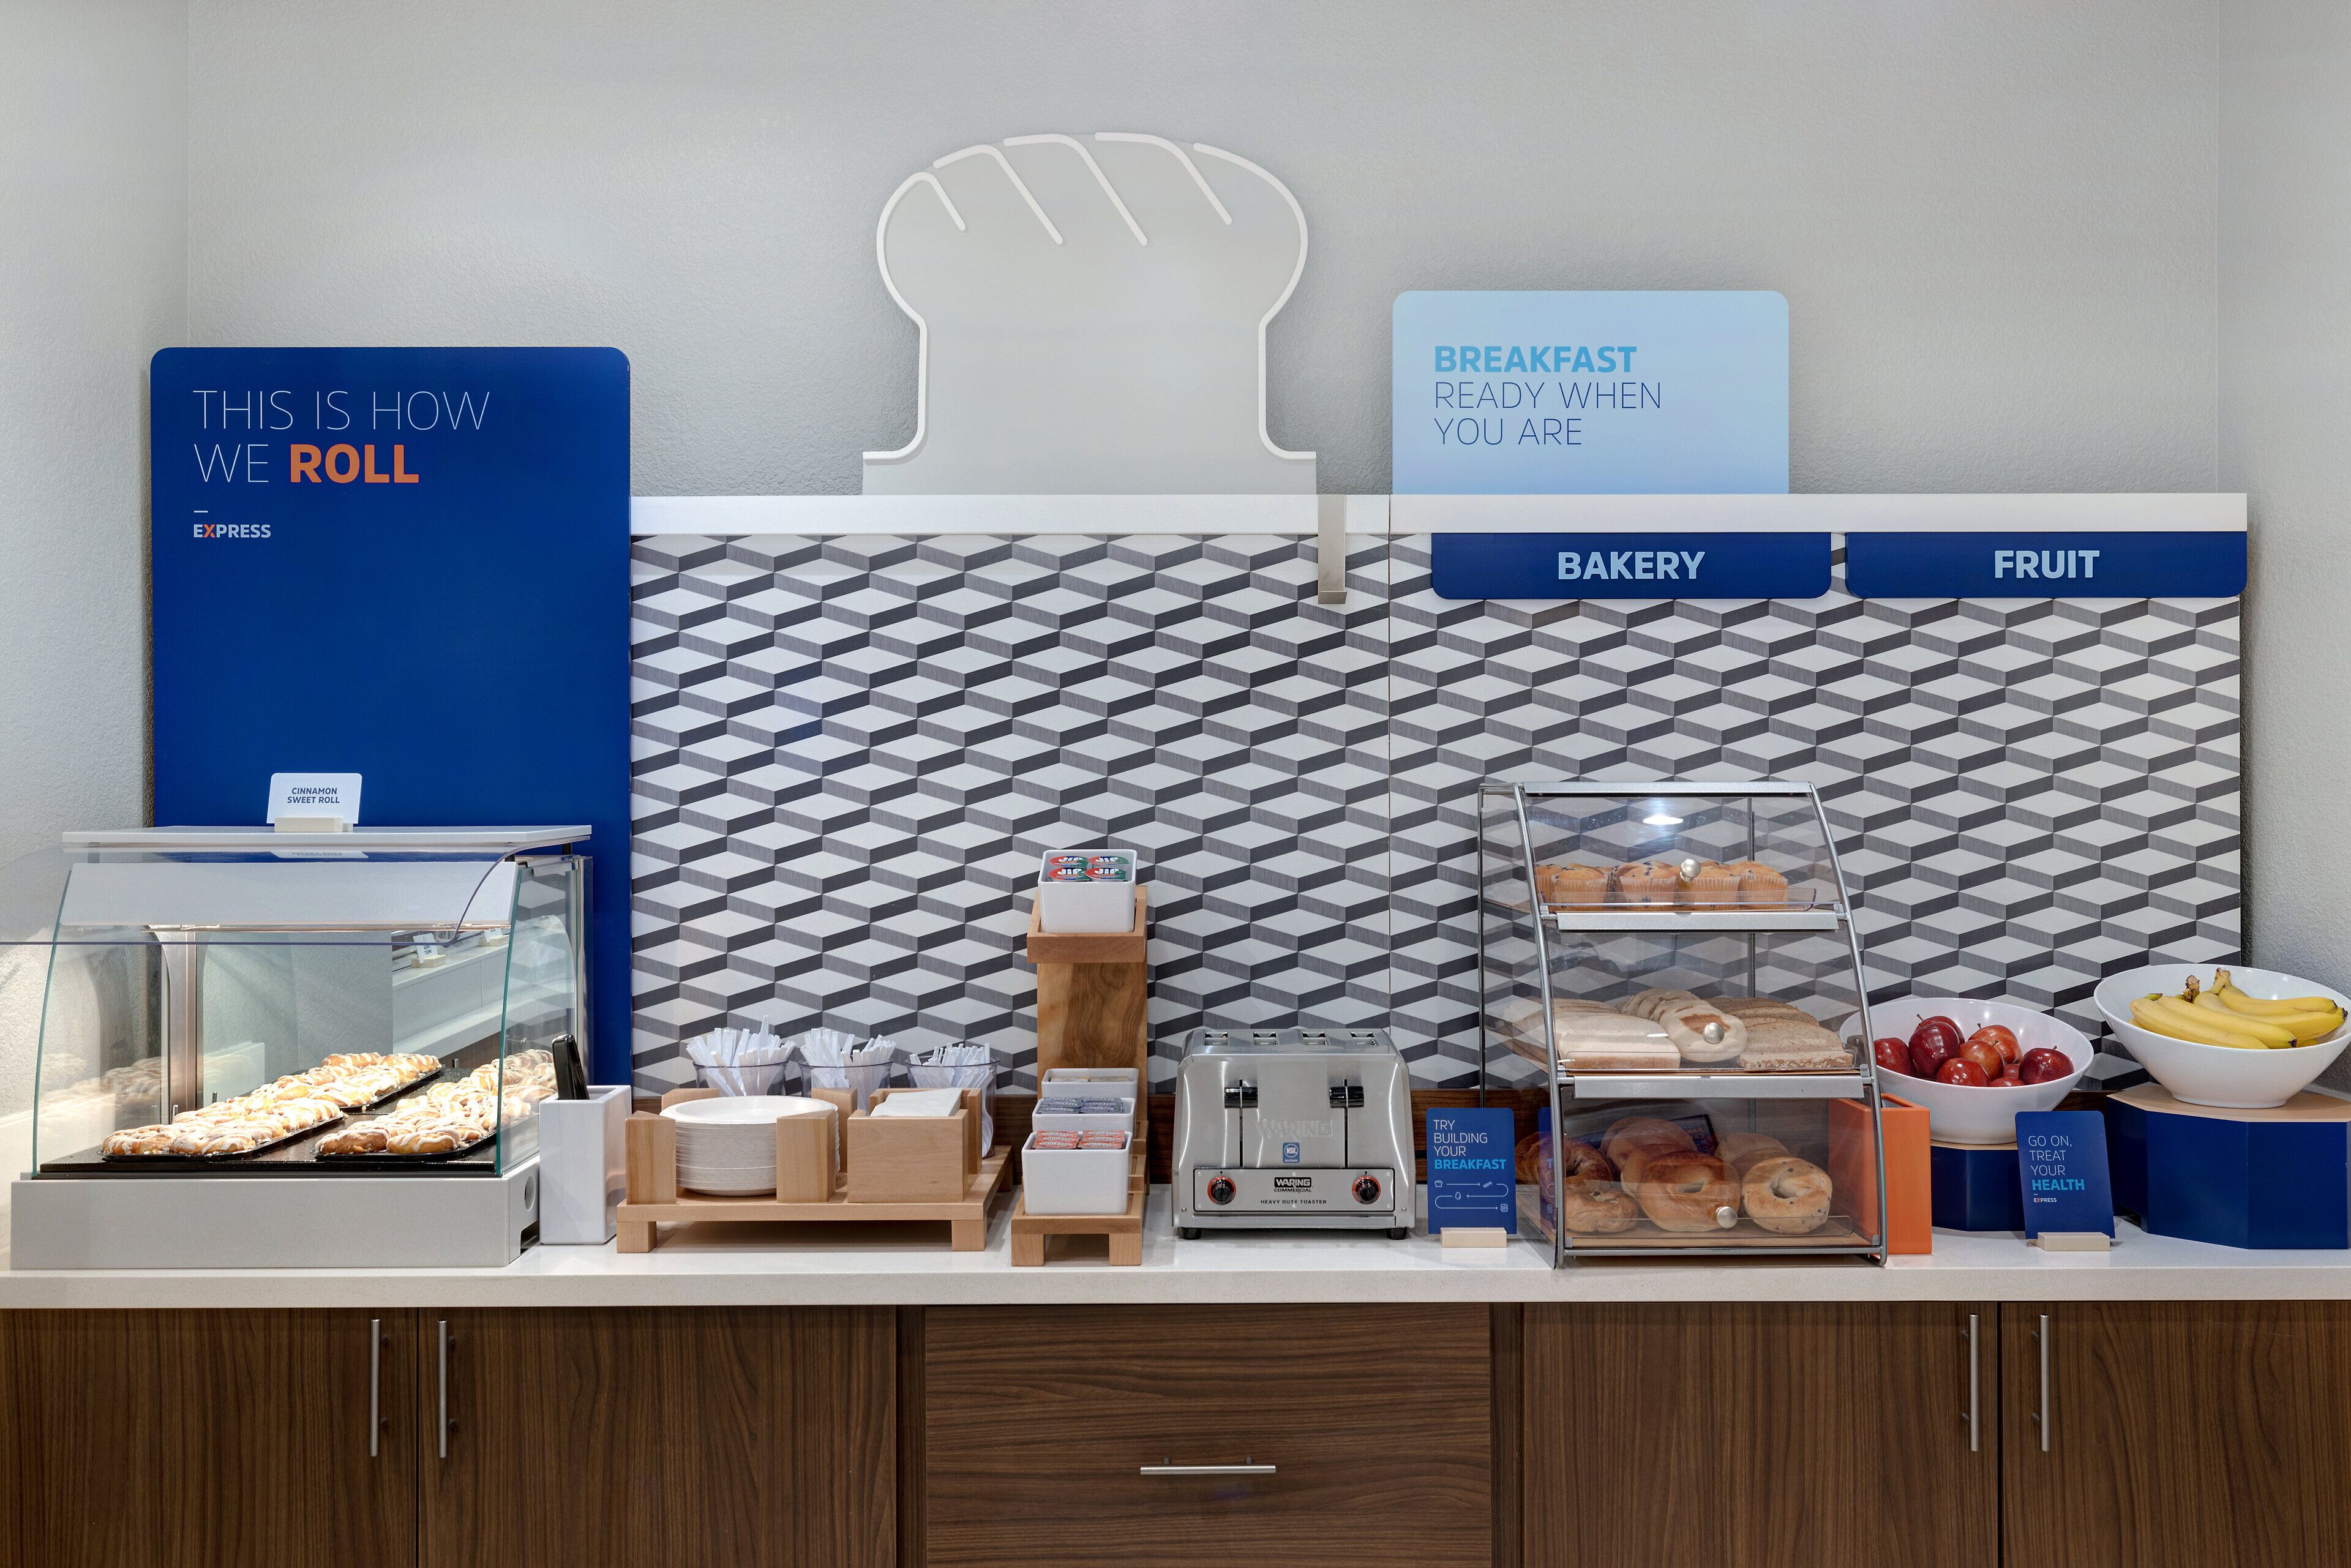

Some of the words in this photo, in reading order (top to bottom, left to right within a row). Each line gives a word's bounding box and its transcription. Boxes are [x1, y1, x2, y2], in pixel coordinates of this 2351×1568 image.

[1435, 345, 1637, 373] BREAKFAST
[1435, 381, 1545, 409] READY
[1558, 382, 1660, 409] WHEN
[192, 390, 293, 430] THIS
[317, 391, 350, 430] IS
[373, 391, 490, 430] HOW
[1434, 418, 1503, 445] YOU
[1518, 418, 1582, 445] ARE
[193, 443, 269, 482] WE
[290, 443, 419, 484] ROLL
[193, 523, 271, 538] EXPRESS
[1558, 551, 1706, 580] BAKERY
[1994, 550, 2100, 579] FRUIT
[1254, 1119, 1332, 1141] WARING
[1433, 1119, 1455, 1130] TRY
[1434, 1133, 1488, 1144] BUILDING
[2028, 1135, 2047, 1147] GO
[2051, 1135, 2072, 1147] ON,
[1433, 1146, 1466, 1157] YOUR
[2029, 1150, 2066, 1161] TREAT
[1434, 1159, 1507, 1170] BREAKFAST
[2030, 1165, 2066, 1176] YOUR
[1275, 1178, 1311, 1188] WARING
[2031, 1179, 2085, 1191] HEALTH
